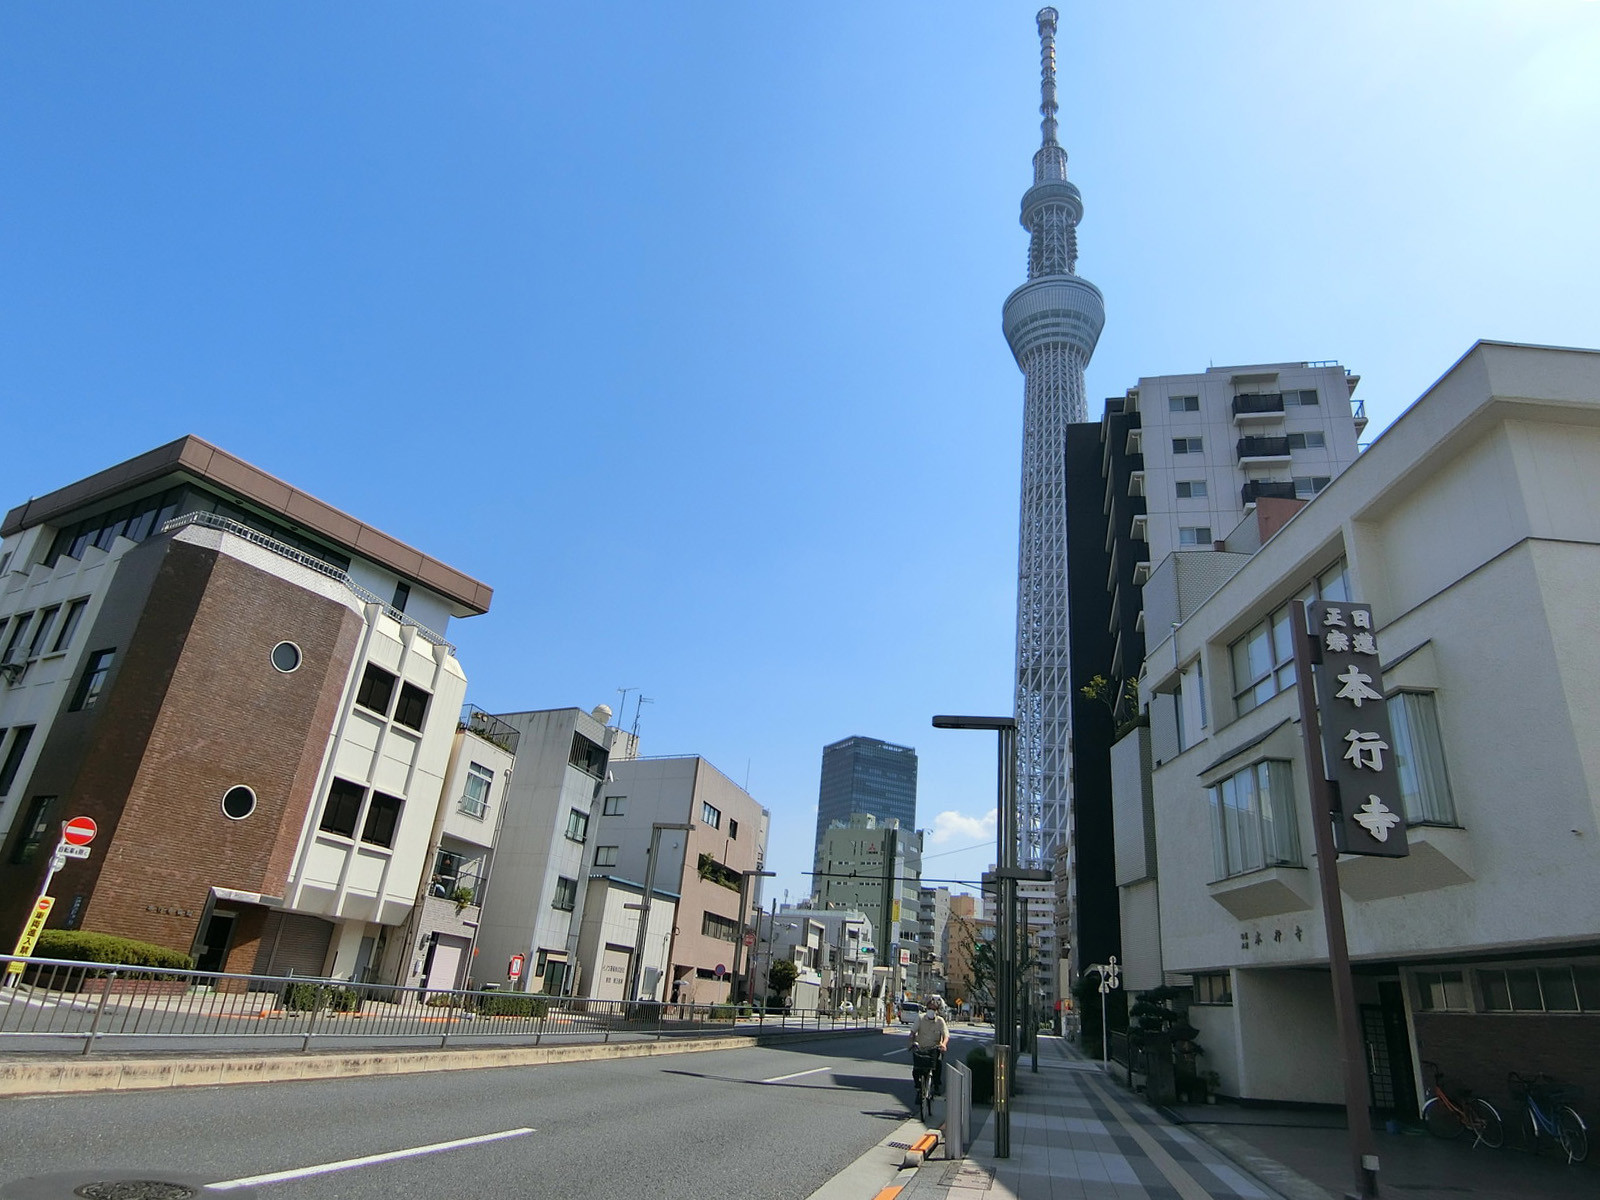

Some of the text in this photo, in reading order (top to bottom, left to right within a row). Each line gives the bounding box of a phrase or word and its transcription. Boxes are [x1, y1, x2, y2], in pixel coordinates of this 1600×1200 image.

[1336, 665, 1400, 842] 本行寺
[19, 911, 45, 957] 車両進入禁
